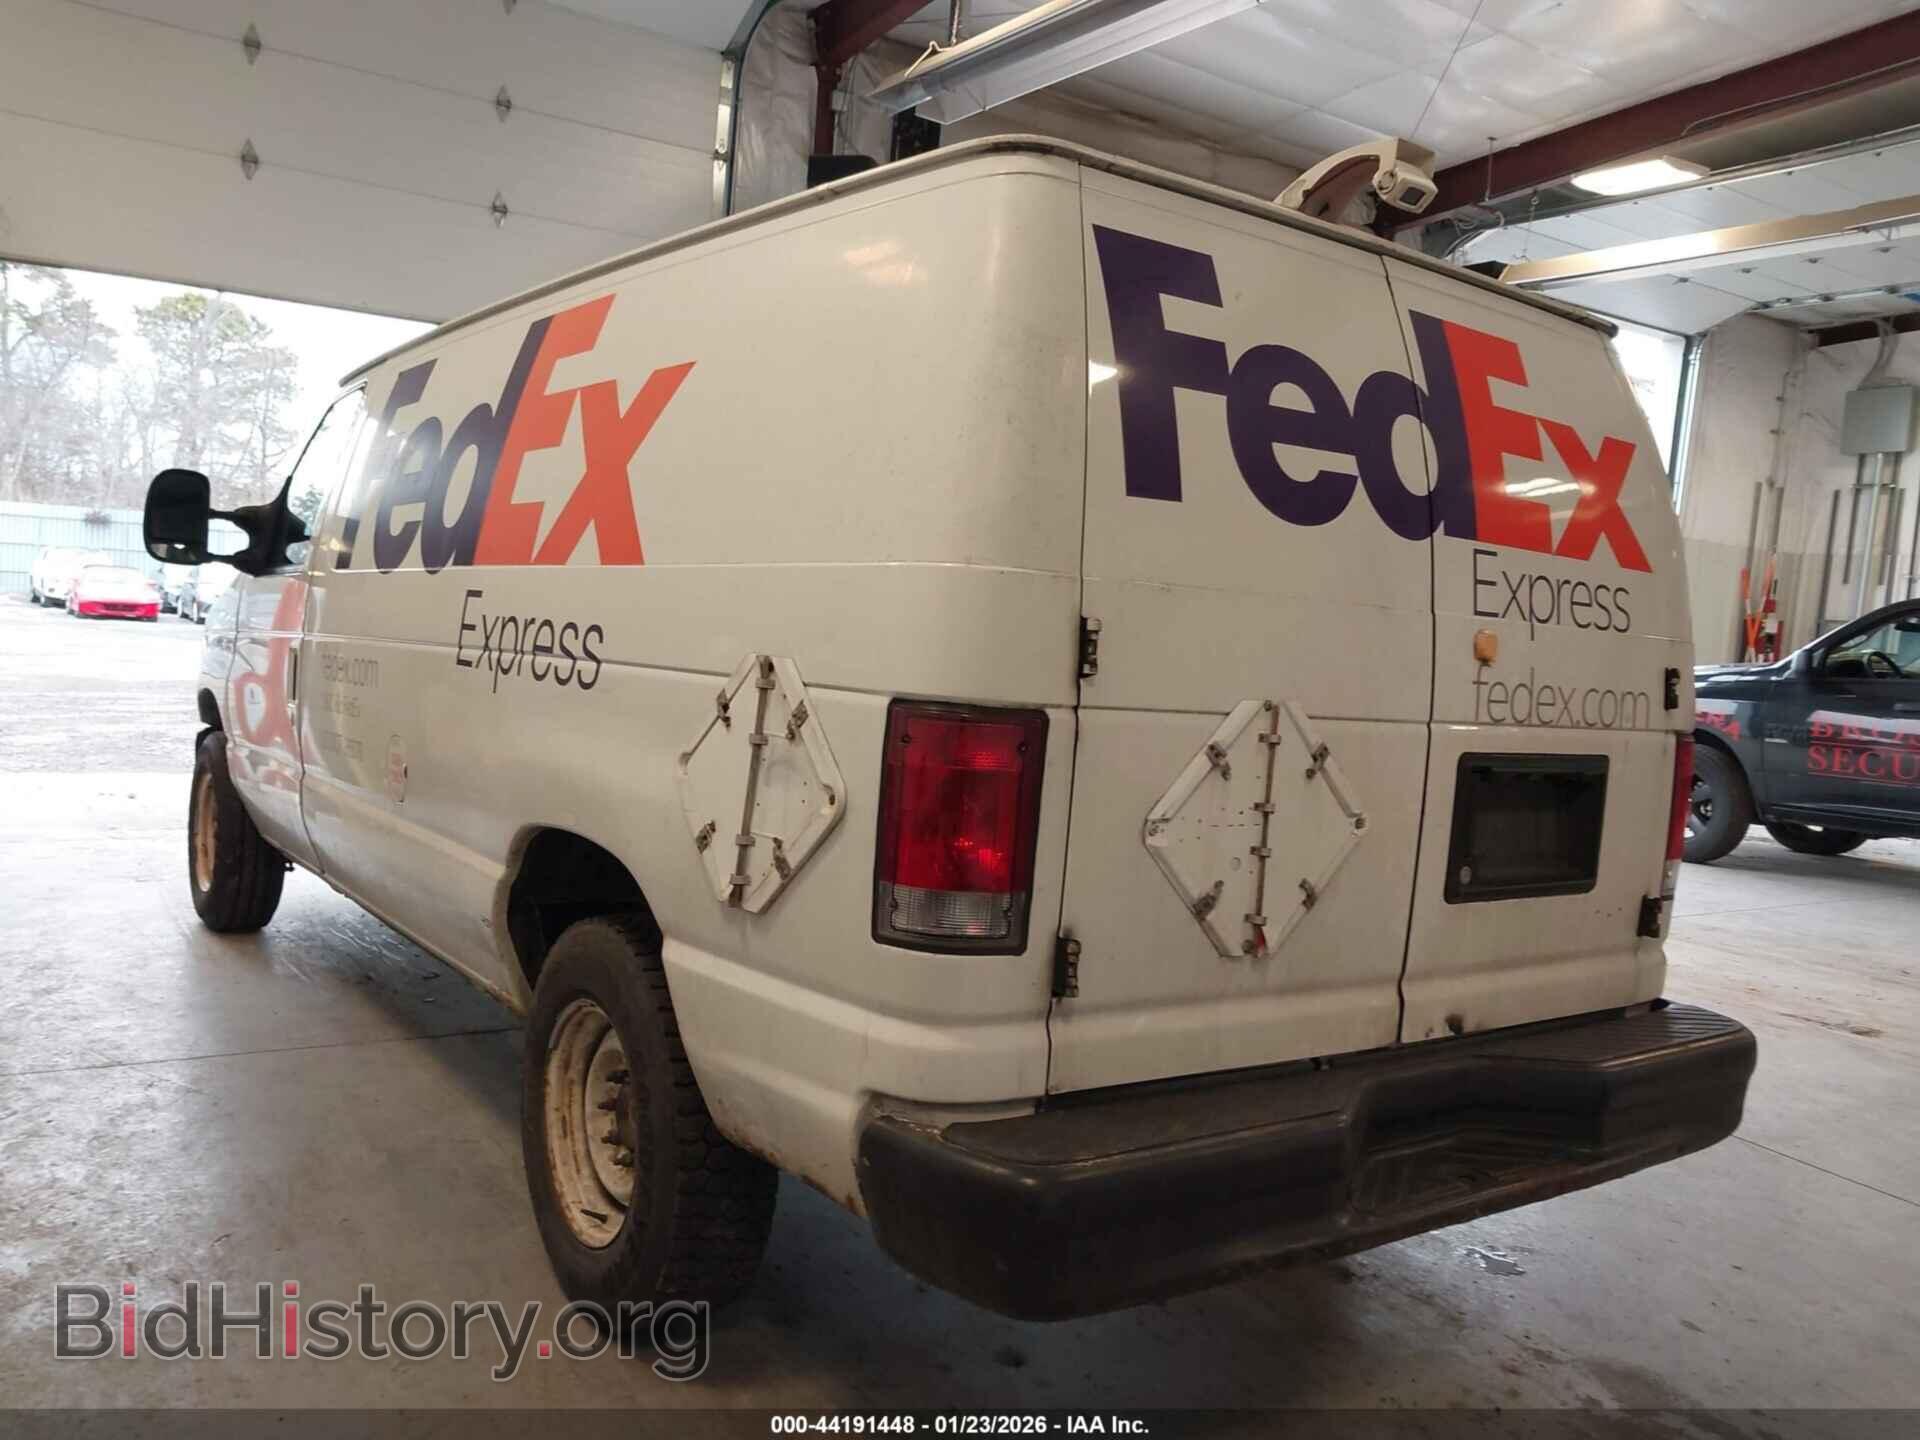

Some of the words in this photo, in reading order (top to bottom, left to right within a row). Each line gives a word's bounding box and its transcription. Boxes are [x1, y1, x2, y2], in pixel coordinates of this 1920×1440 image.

[334, 293, 697, 574] FedEx
[1092, 224, 1653, 573] FedEx
[456, 589, 604, 693] Express
[1473, 549, 1631, 640] Express
[1472, 664, 1651, 730] fedex.com
